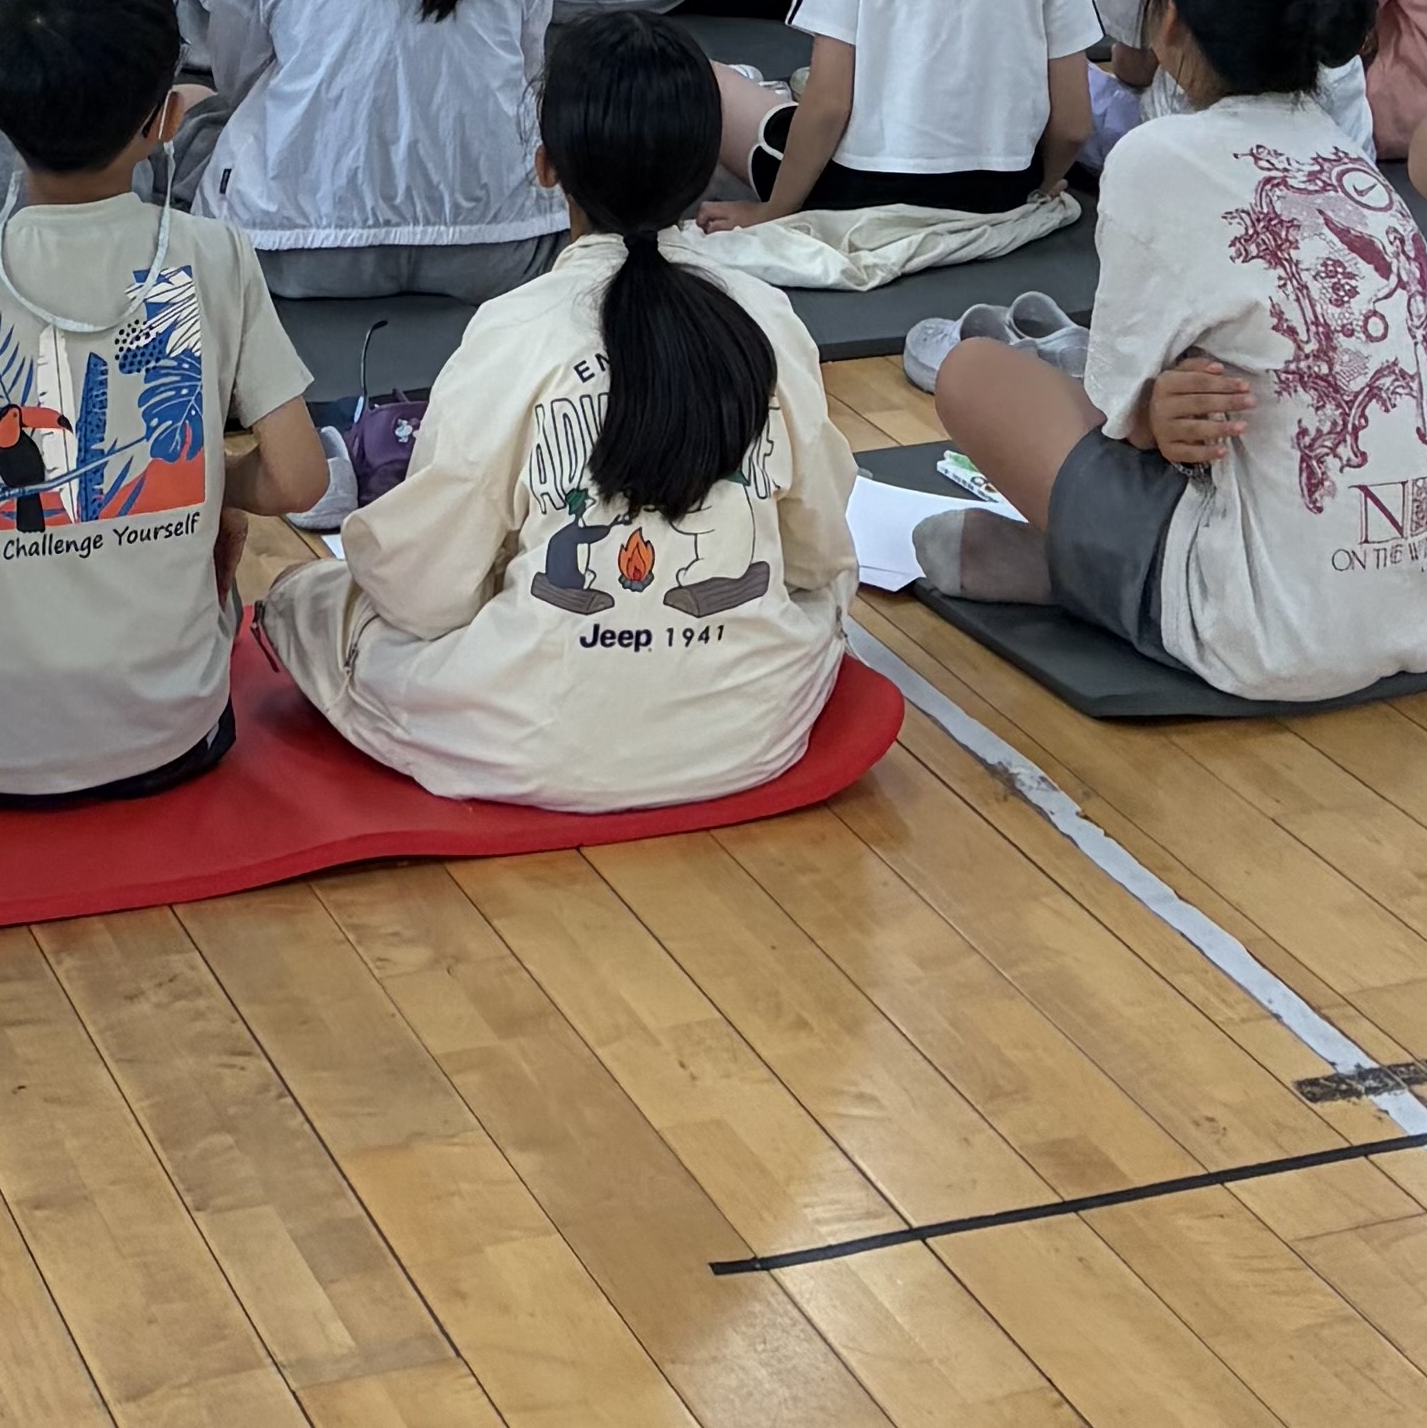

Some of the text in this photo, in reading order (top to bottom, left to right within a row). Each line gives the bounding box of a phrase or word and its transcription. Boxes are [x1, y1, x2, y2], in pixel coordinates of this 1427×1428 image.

[3, 512, 201, 560] Challenge Yourself
[579, 623, 725, 653] Jeep 1941
